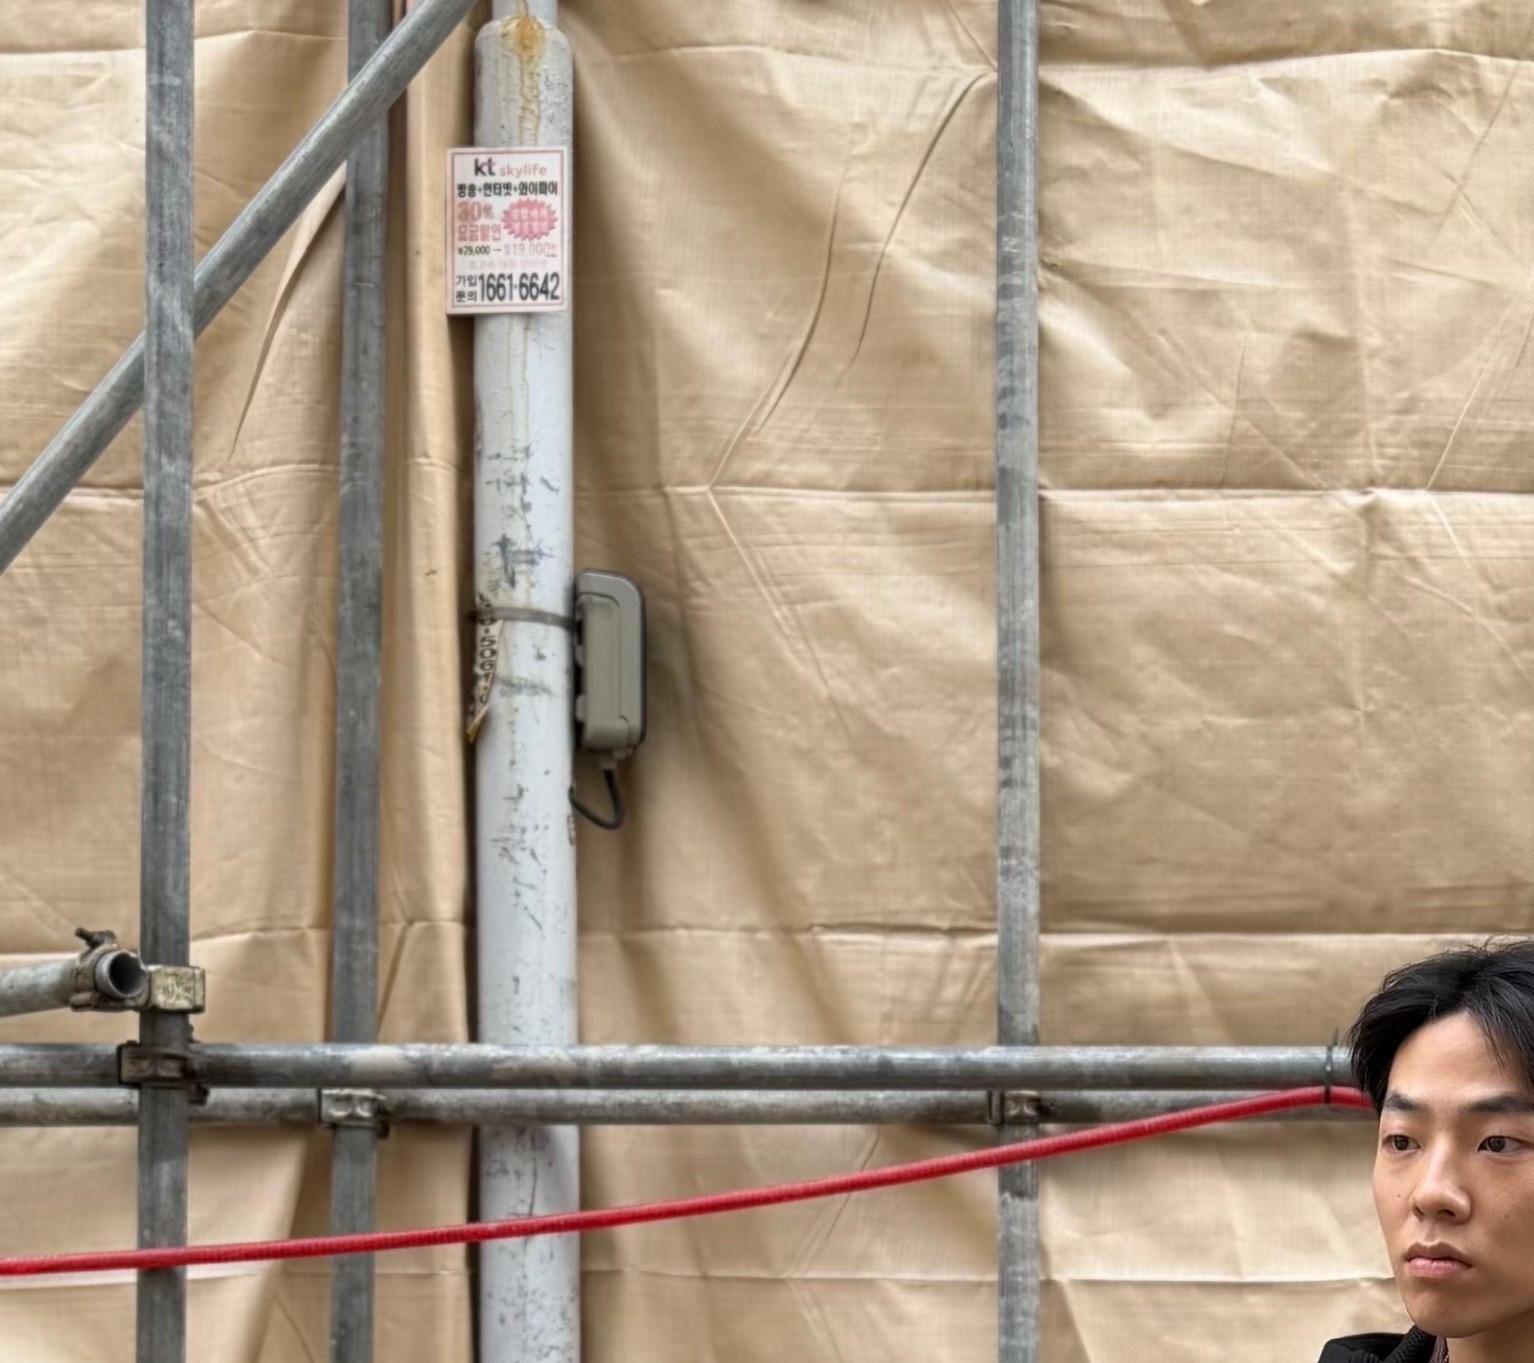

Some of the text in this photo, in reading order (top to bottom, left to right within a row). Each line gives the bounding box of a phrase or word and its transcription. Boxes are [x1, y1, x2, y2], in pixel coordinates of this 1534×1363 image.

[474, 157, 547, 178] kt skylife
[456, 274, 477, 288] 가입
